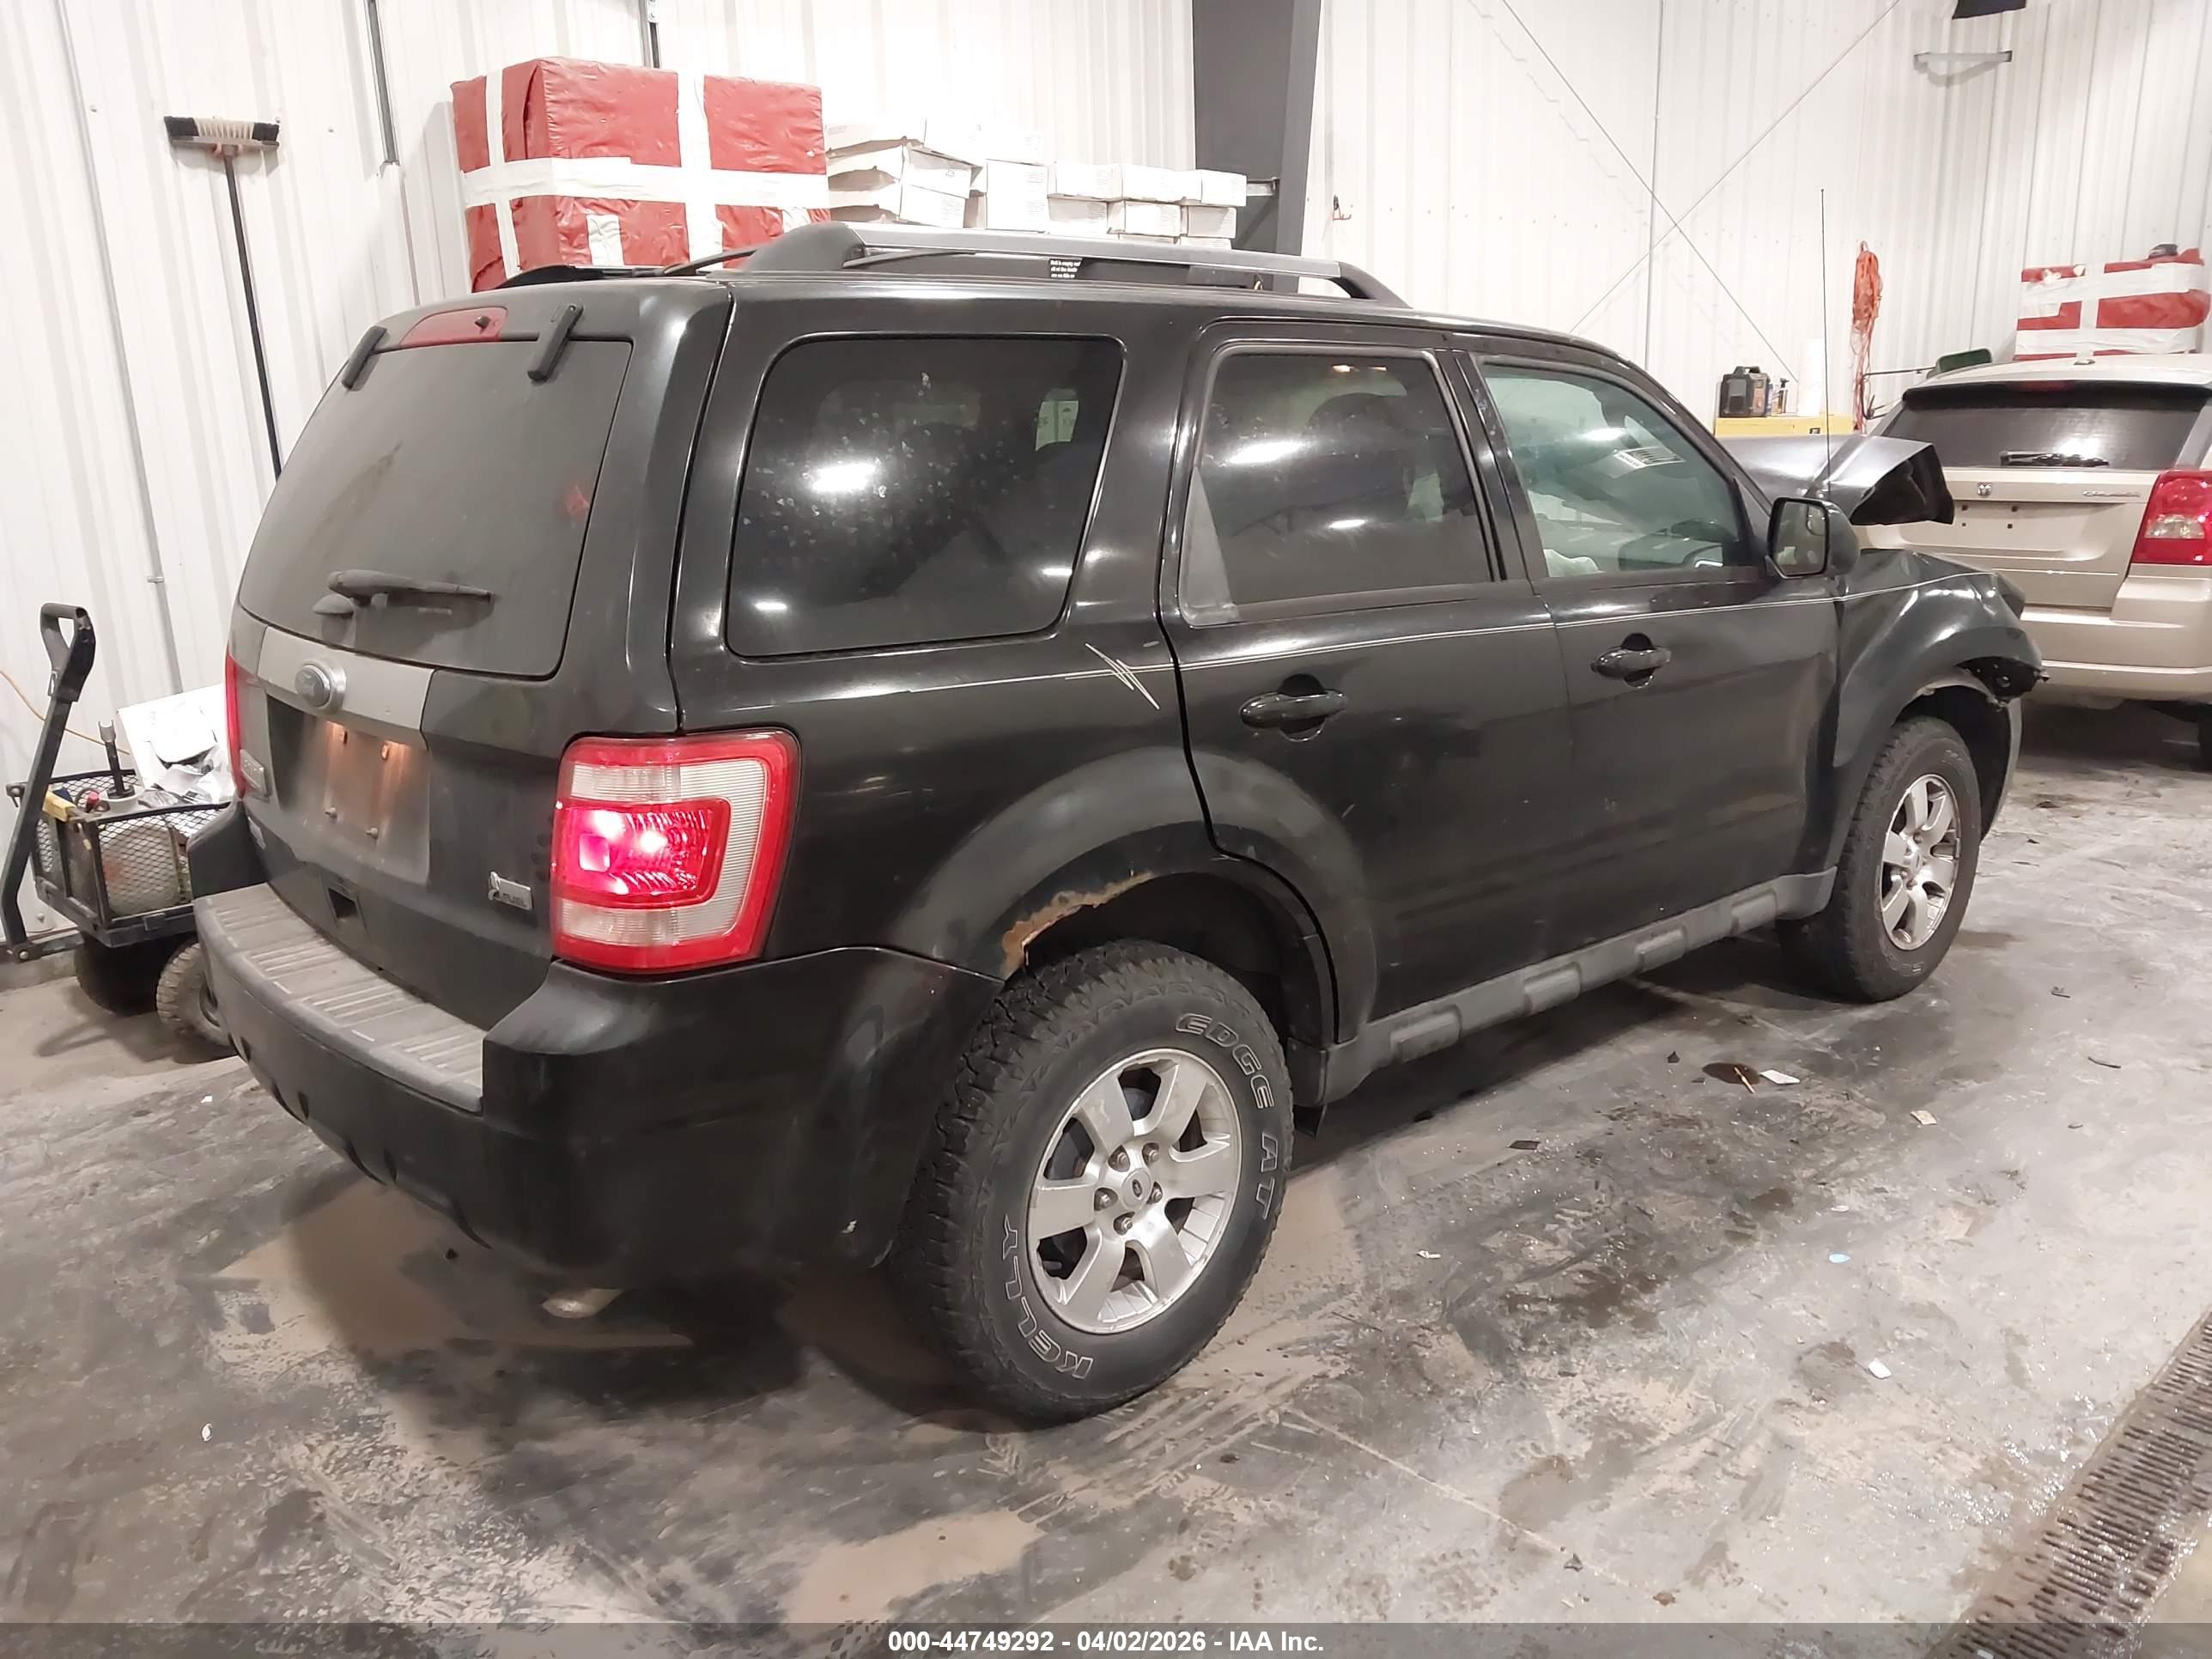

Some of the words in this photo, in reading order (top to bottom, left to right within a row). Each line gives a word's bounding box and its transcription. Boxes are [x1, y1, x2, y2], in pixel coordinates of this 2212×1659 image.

[1176, 1013, 1274, 1109] EDGE
[1255, 1133, 1279, 1220] AT
[1002, 1213, 1094, 1379] KELLY
